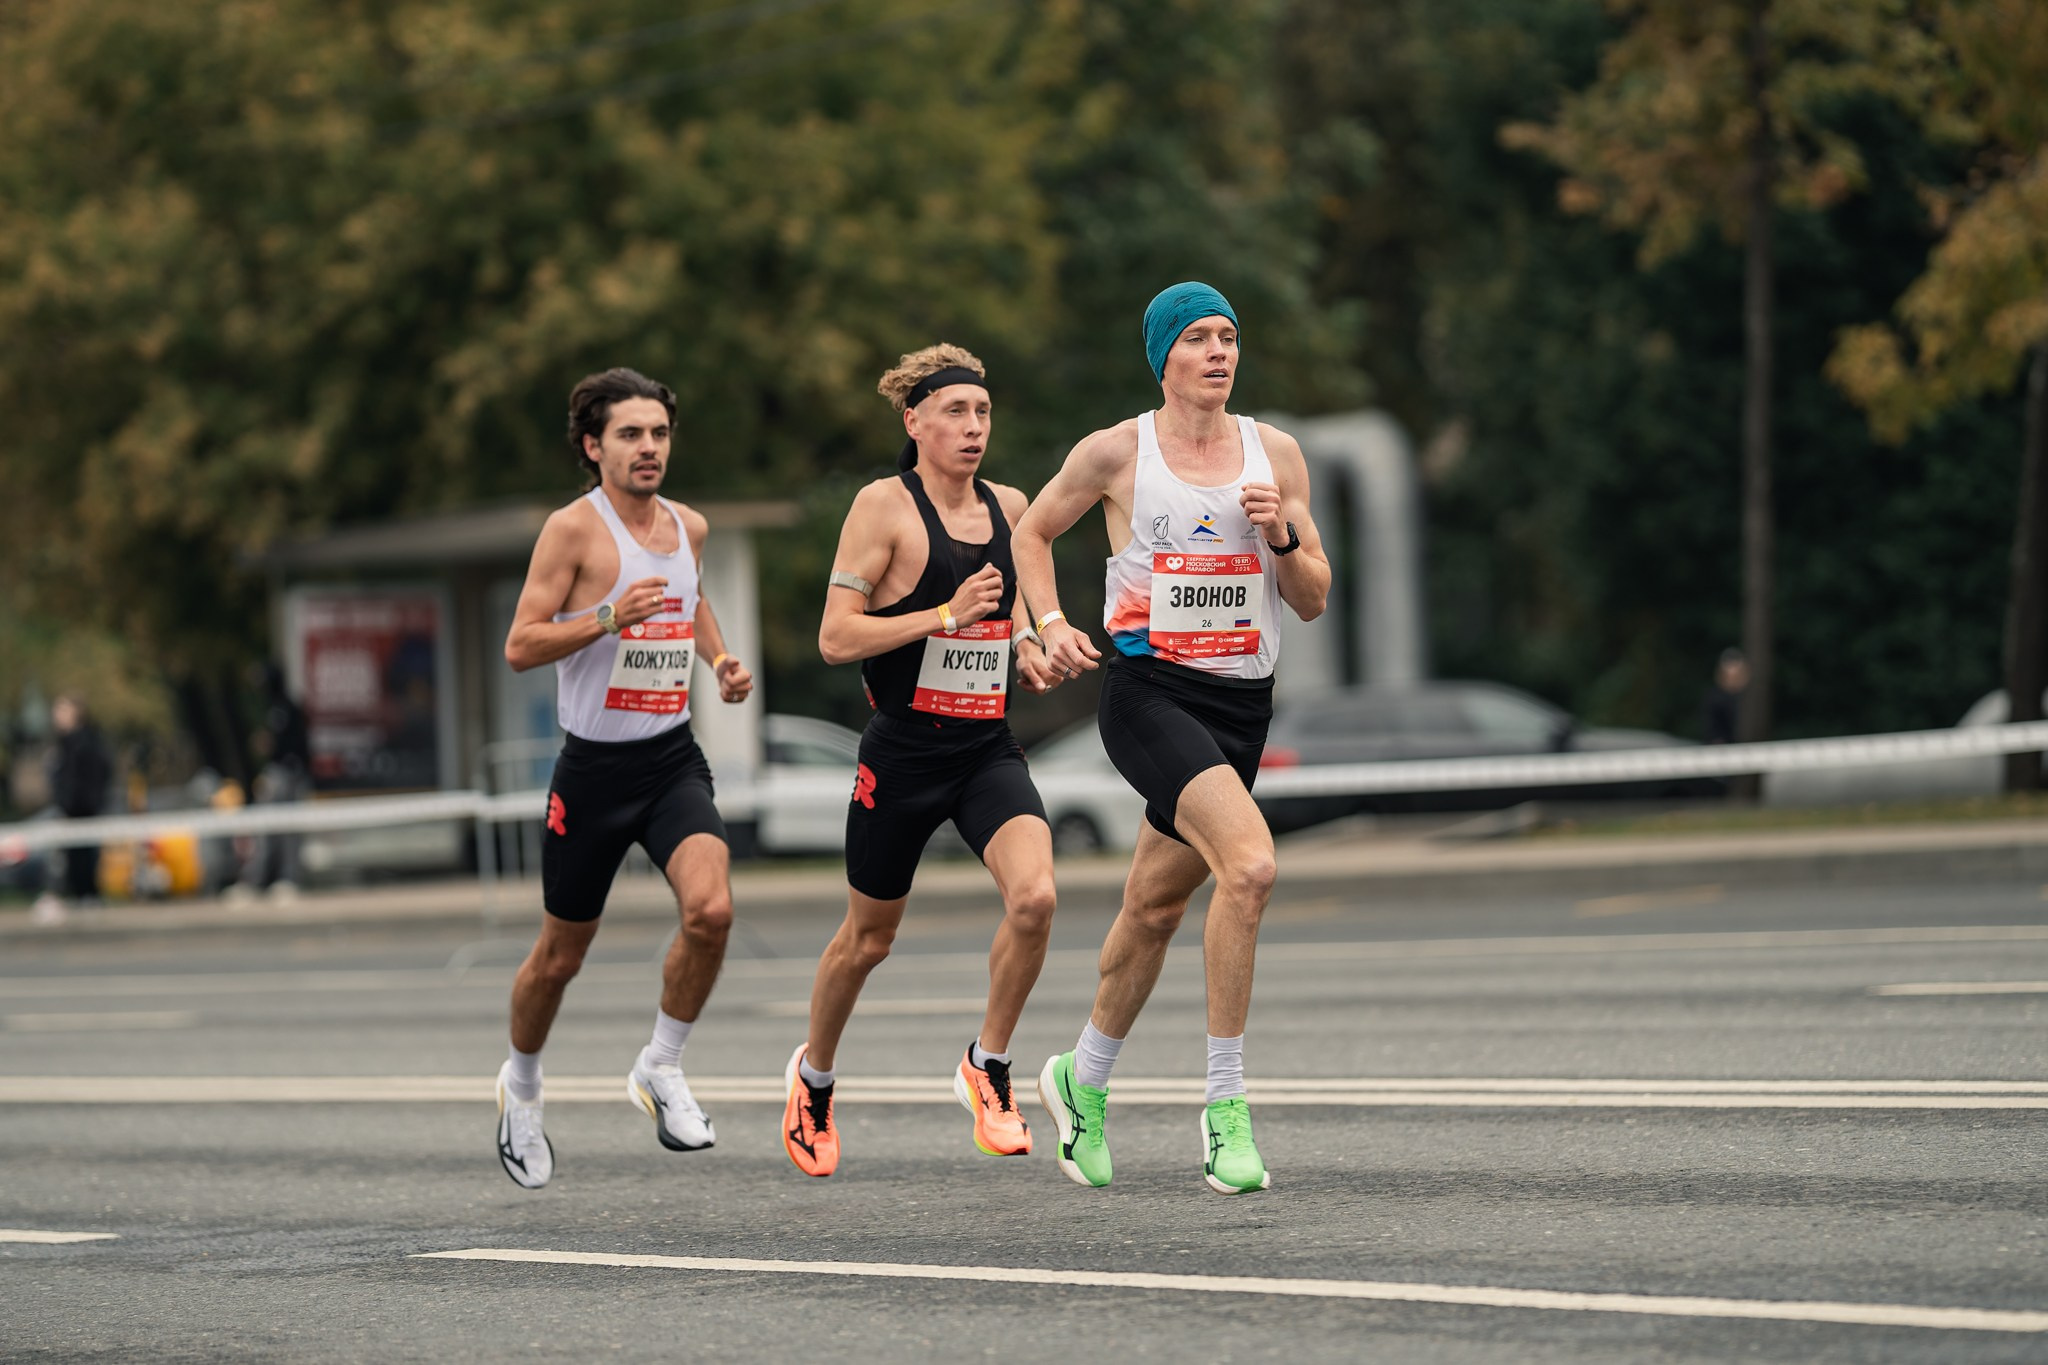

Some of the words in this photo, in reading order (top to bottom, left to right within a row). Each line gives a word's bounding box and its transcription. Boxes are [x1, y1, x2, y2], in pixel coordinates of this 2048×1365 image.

[1170, 585, 1247, 608] ЗВОНОВ
[1201, 619, 1213, 628] 26
[623, 650, 689, 670] КОЖУХОВ
[942, 649, 999, 672] КУСТОВ
[966, 681, 975, 690] 18
